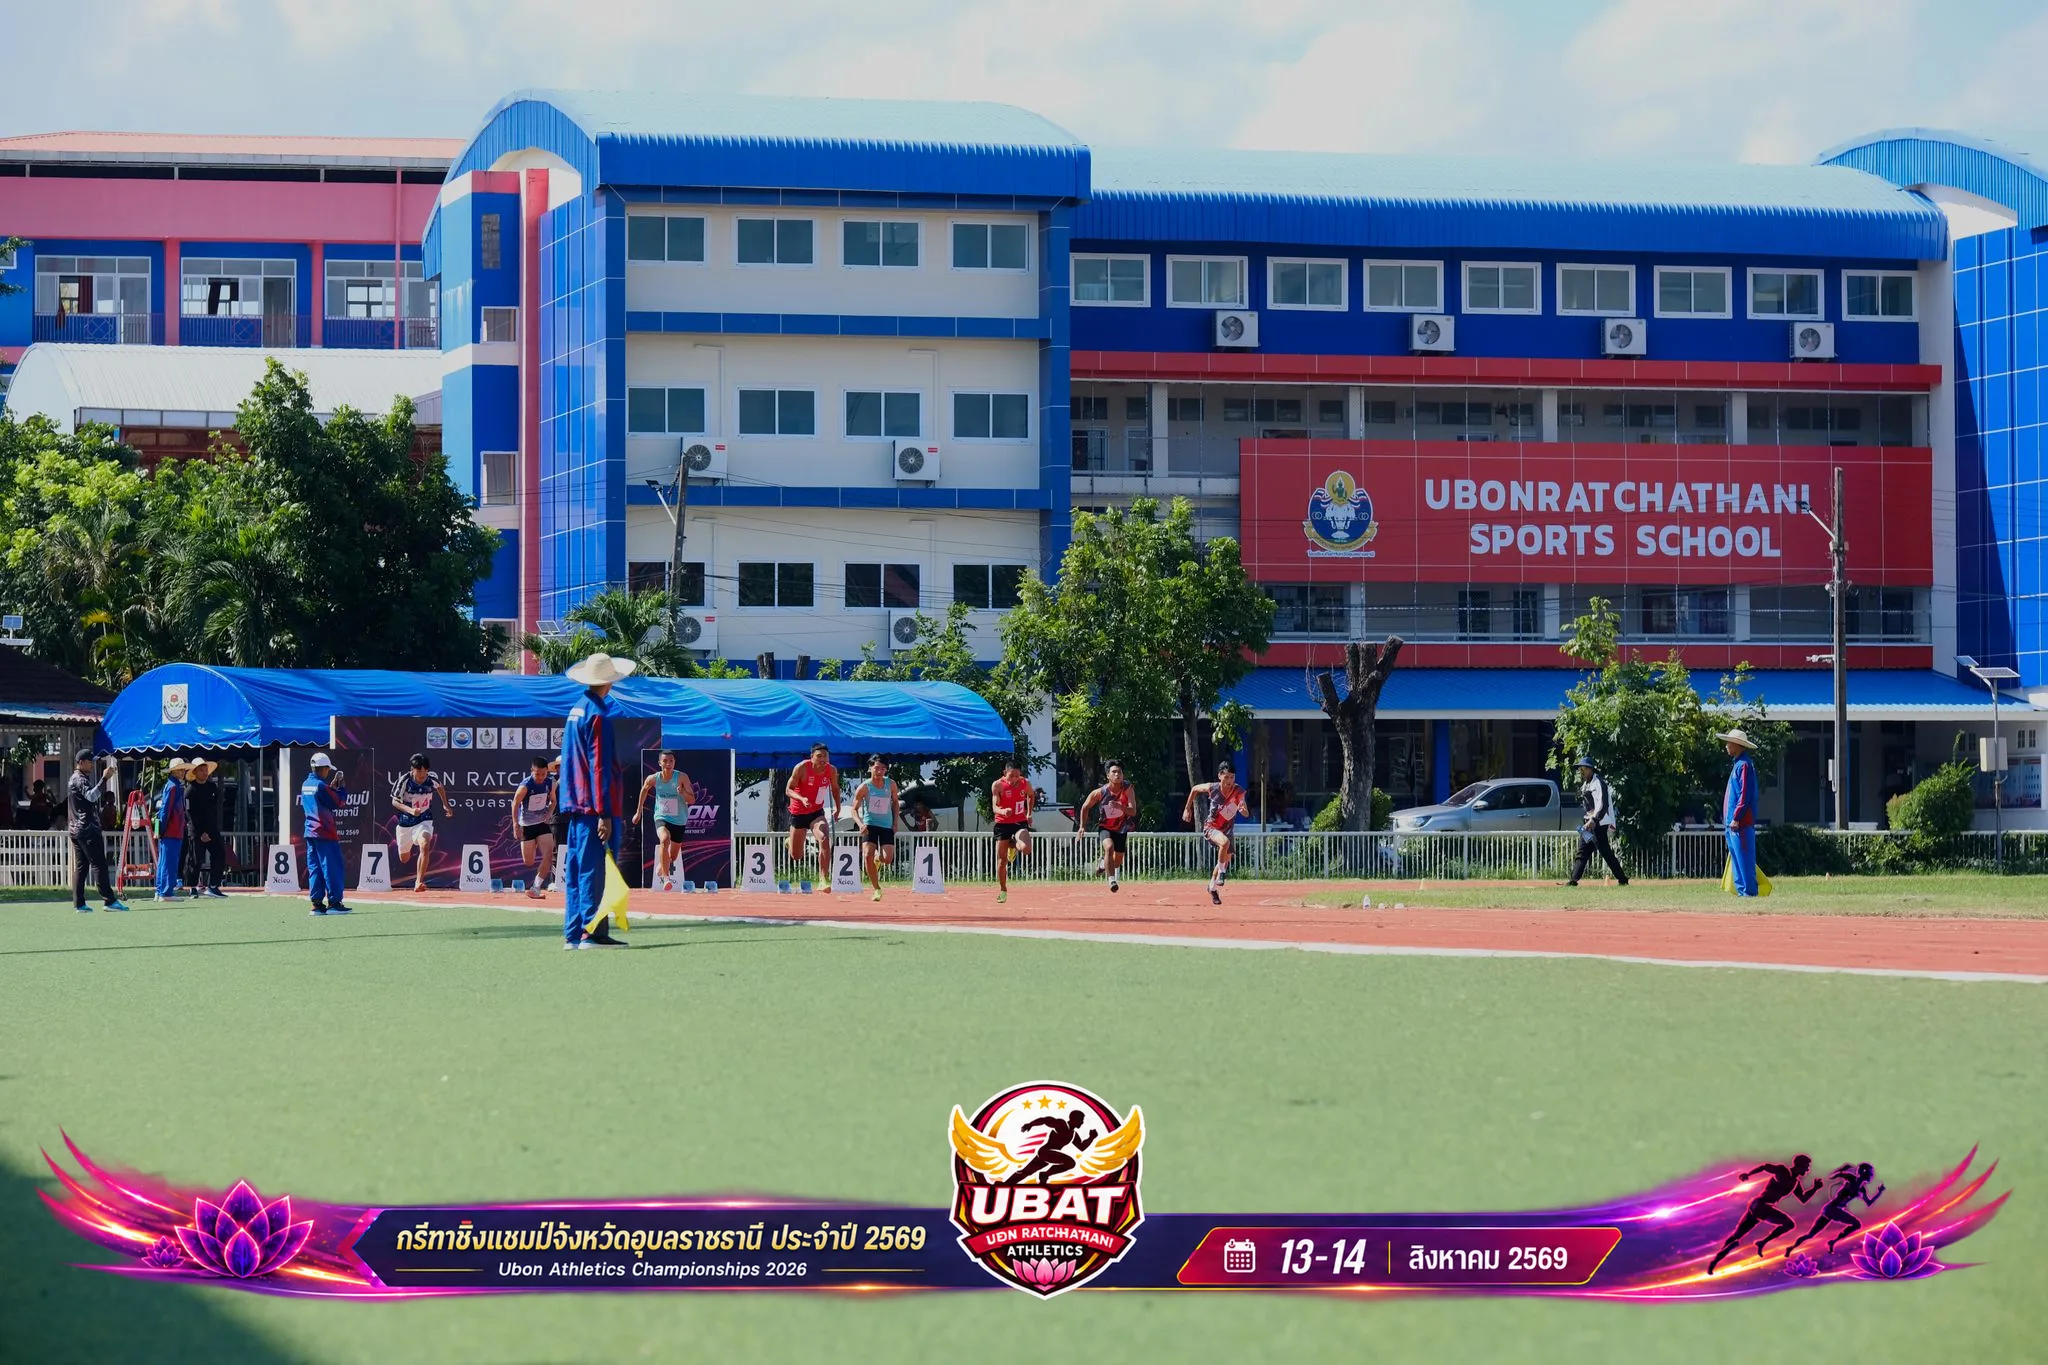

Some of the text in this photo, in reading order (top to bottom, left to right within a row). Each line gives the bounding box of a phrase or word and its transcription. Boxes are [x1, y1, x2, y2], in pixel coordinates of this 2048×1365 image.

[1425, 479, 1811, 515] UBONRATCHATHANI
[1470, 523, 1781, 557] SPORTS SCHOOL
[274, 851, 290, 875] 8
[367, 851, 383, 876] 7
[468, 850, 484, 875] 6
[751, 852, 766, 876] 3
[839, 853, 854, 877] 2
[922, 853, 934, 877] 1
